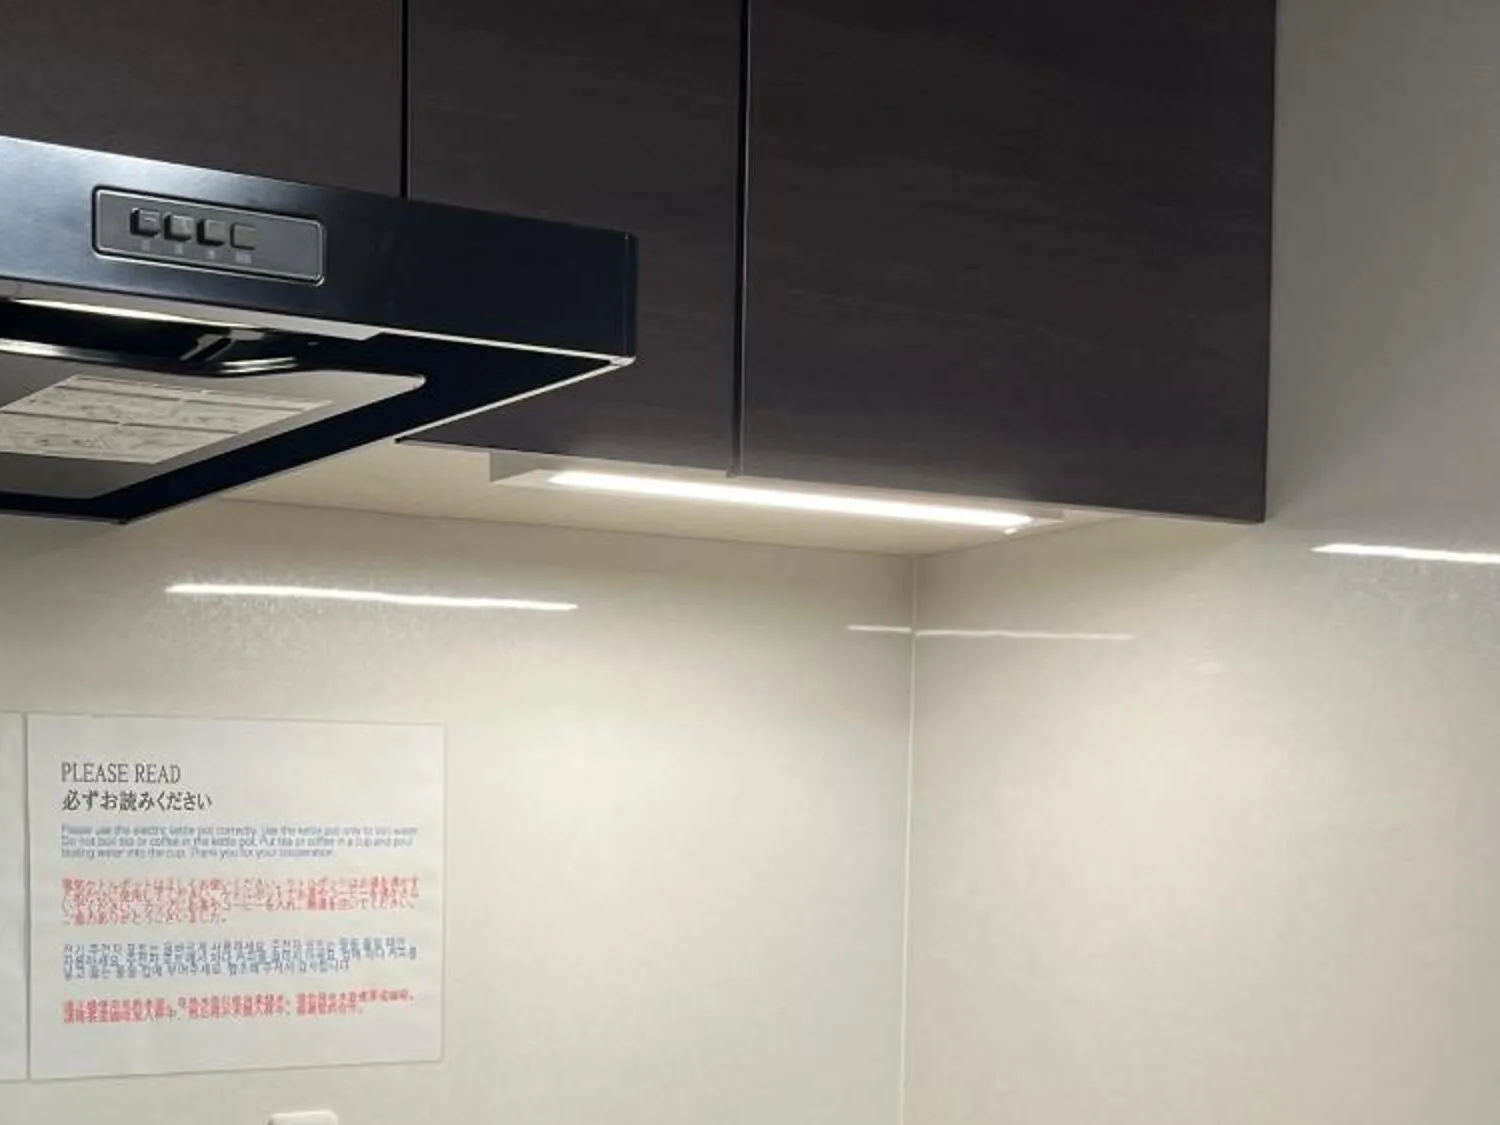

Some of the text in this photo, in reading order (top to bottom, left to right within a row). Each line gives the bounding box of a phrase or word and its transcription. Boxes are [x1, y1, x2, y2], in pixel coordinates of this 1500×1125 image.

[60, 762, 182, 784] PLEASE READ
[62, 789, 214, 811] 必ずお読みください
